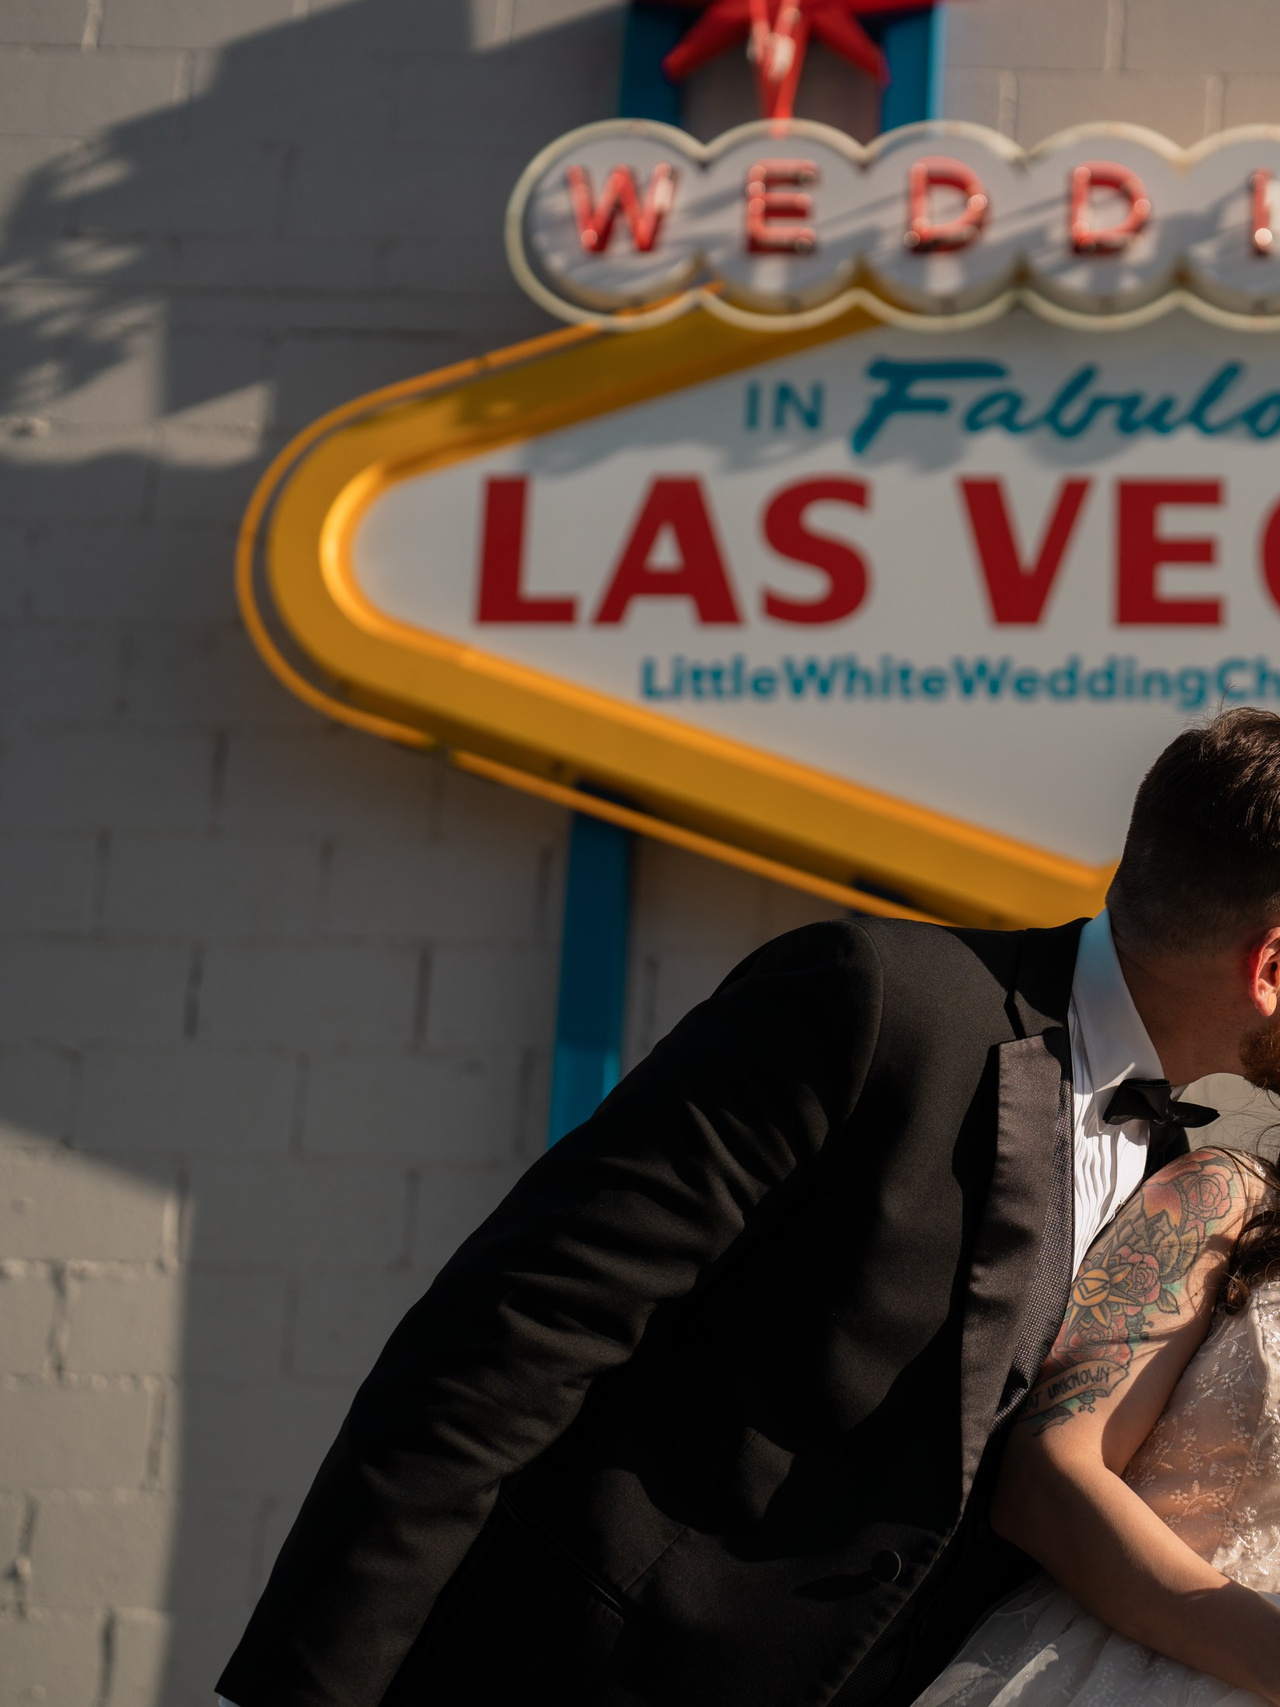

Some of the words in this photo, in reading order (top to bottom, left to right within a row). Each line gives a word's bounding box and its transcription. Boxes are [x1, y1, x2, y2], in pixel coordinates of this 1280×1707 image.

[744, 380, 825, 432] IN
[475, 475, 871, 627] LAS
[1047, 1366, 1110, 1399] UNKNOWN
